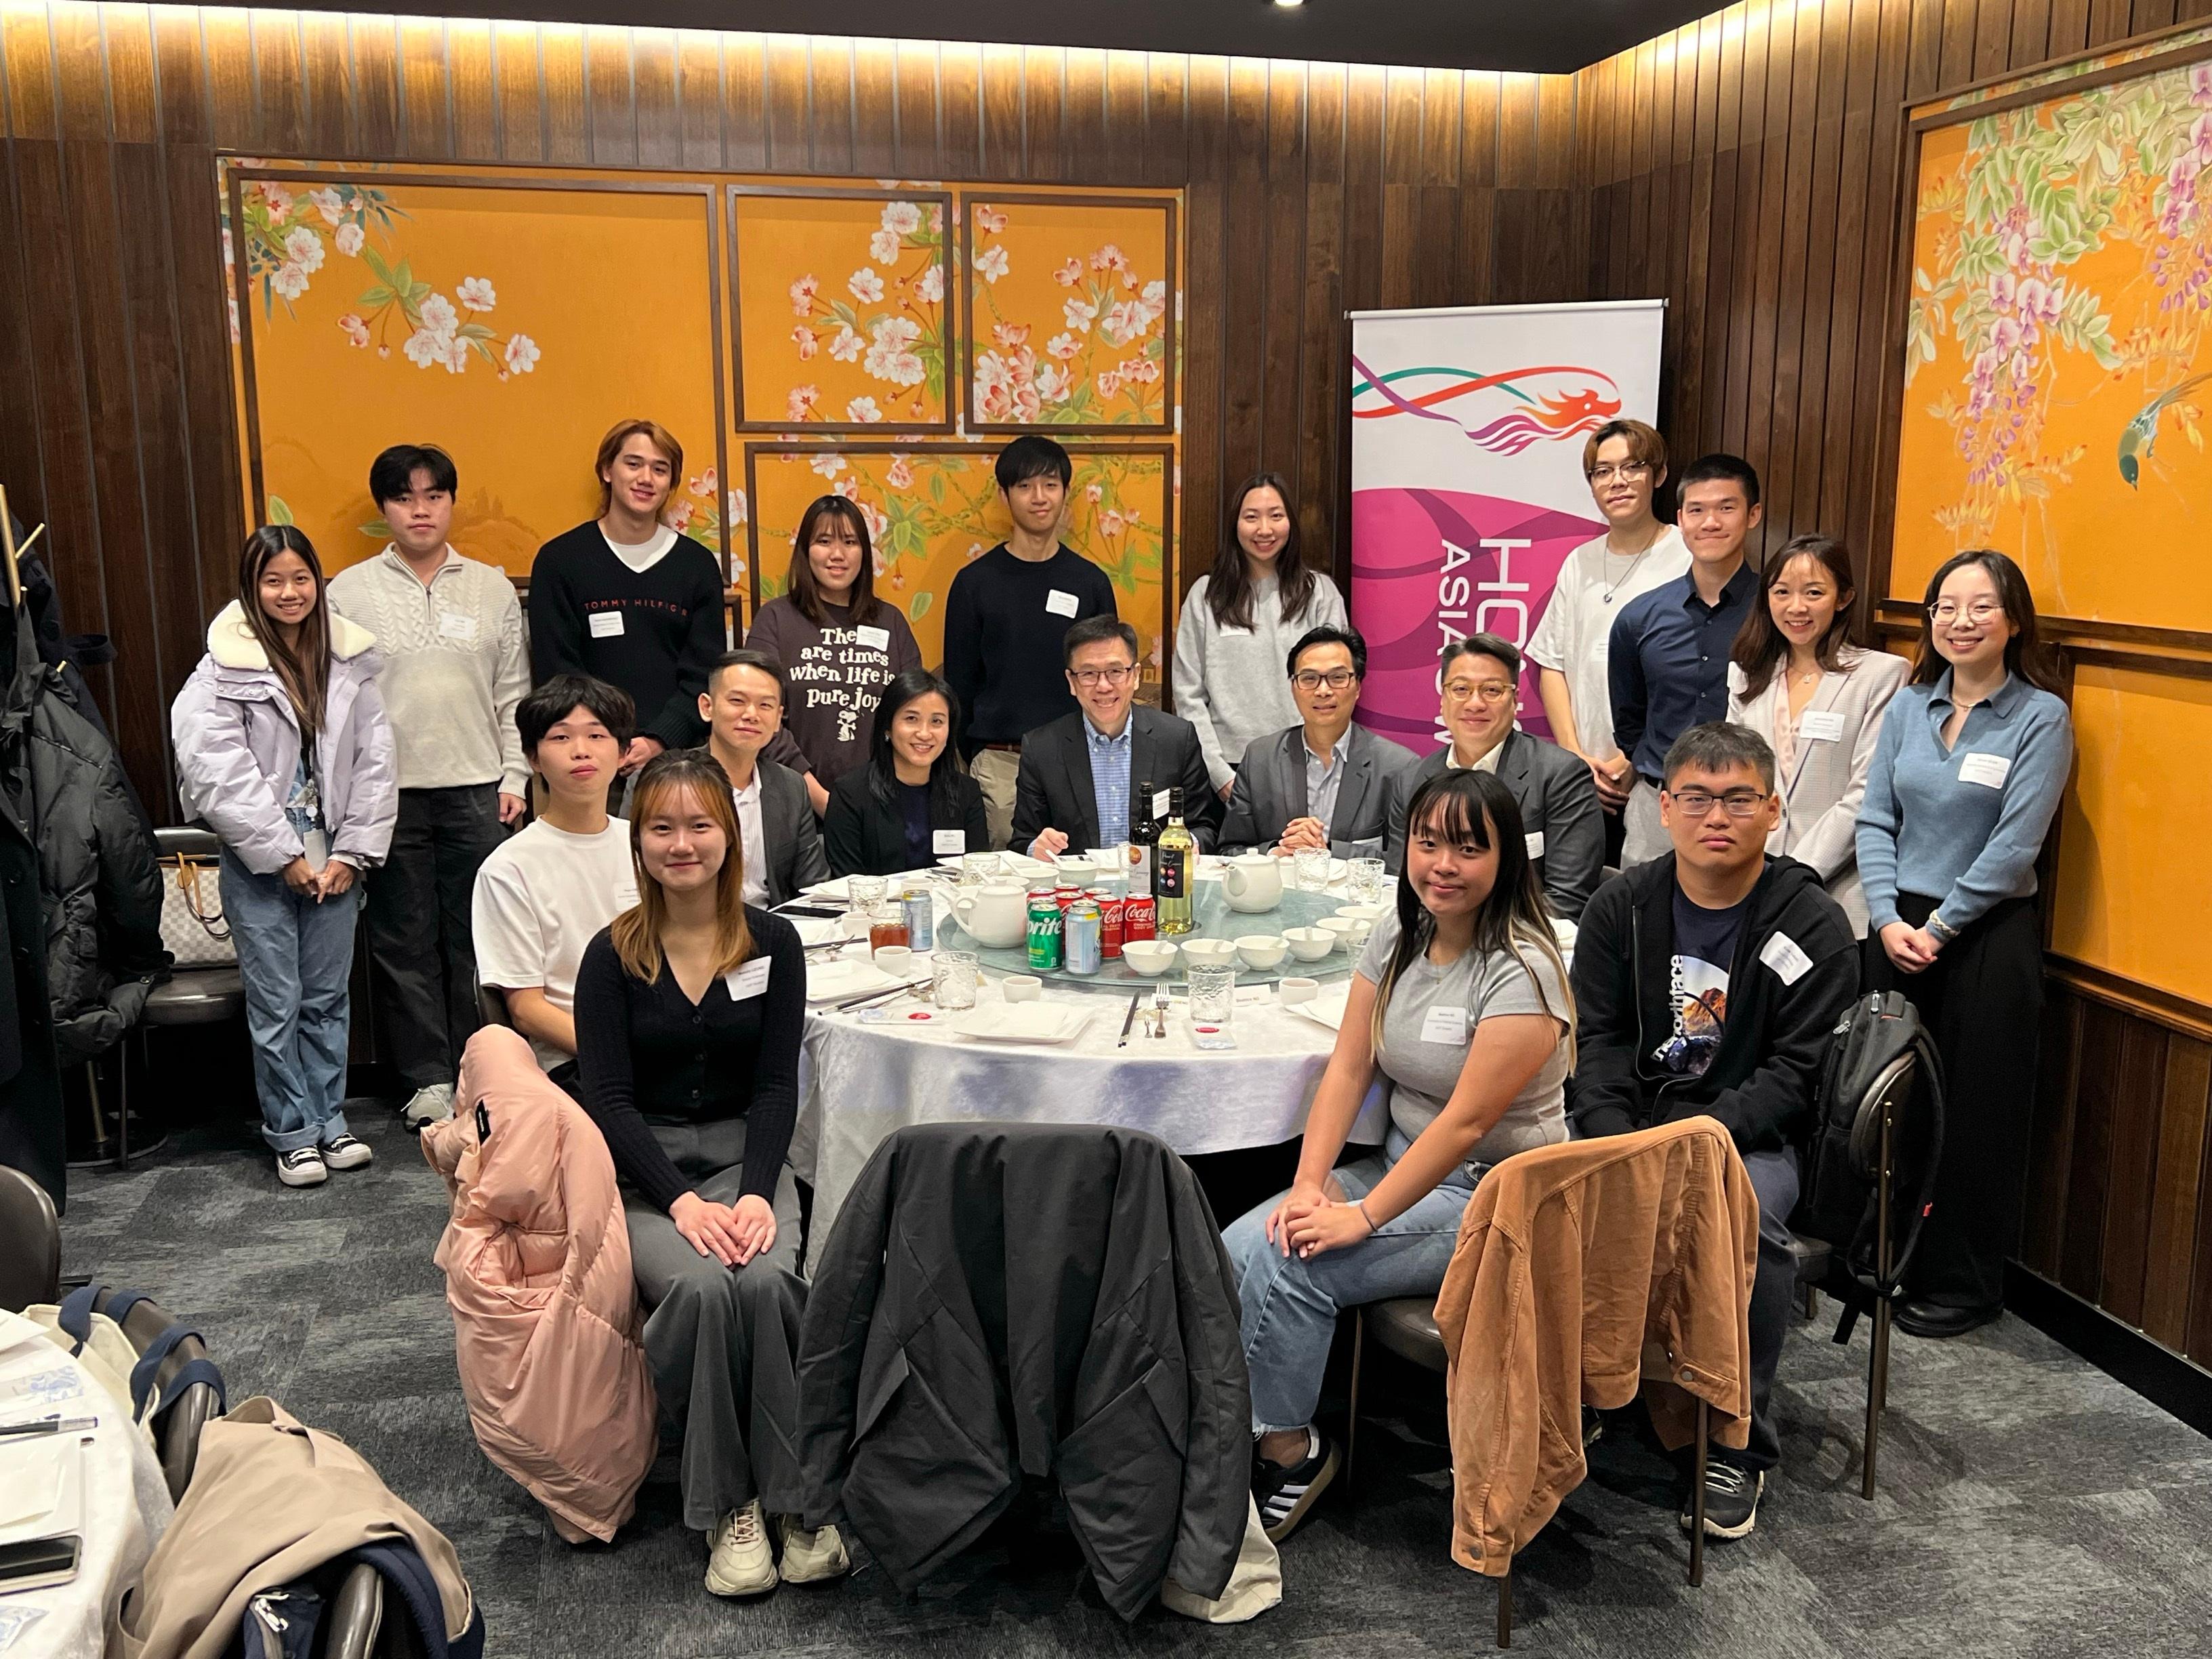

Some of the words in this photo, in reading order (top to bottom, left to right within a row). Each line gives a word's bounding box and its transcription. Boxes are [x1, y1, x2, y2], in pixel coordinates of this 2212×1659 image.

[583, 599, 628, 611] TOMMY
[634, 598, 689, 616] HILFIGR
[820, 628, 857, 645] The
[800, 646, 833, 661] are
[838, 647, 889, 666] times
[790, 663, 842, 681] when
[845, 667, 880, 684] life
[882, 670, 895, 685] is
[806, 689, 850, 708] pure
[849, 687, 881, 712] joy
[1028, 918, 1062, 935] prite
